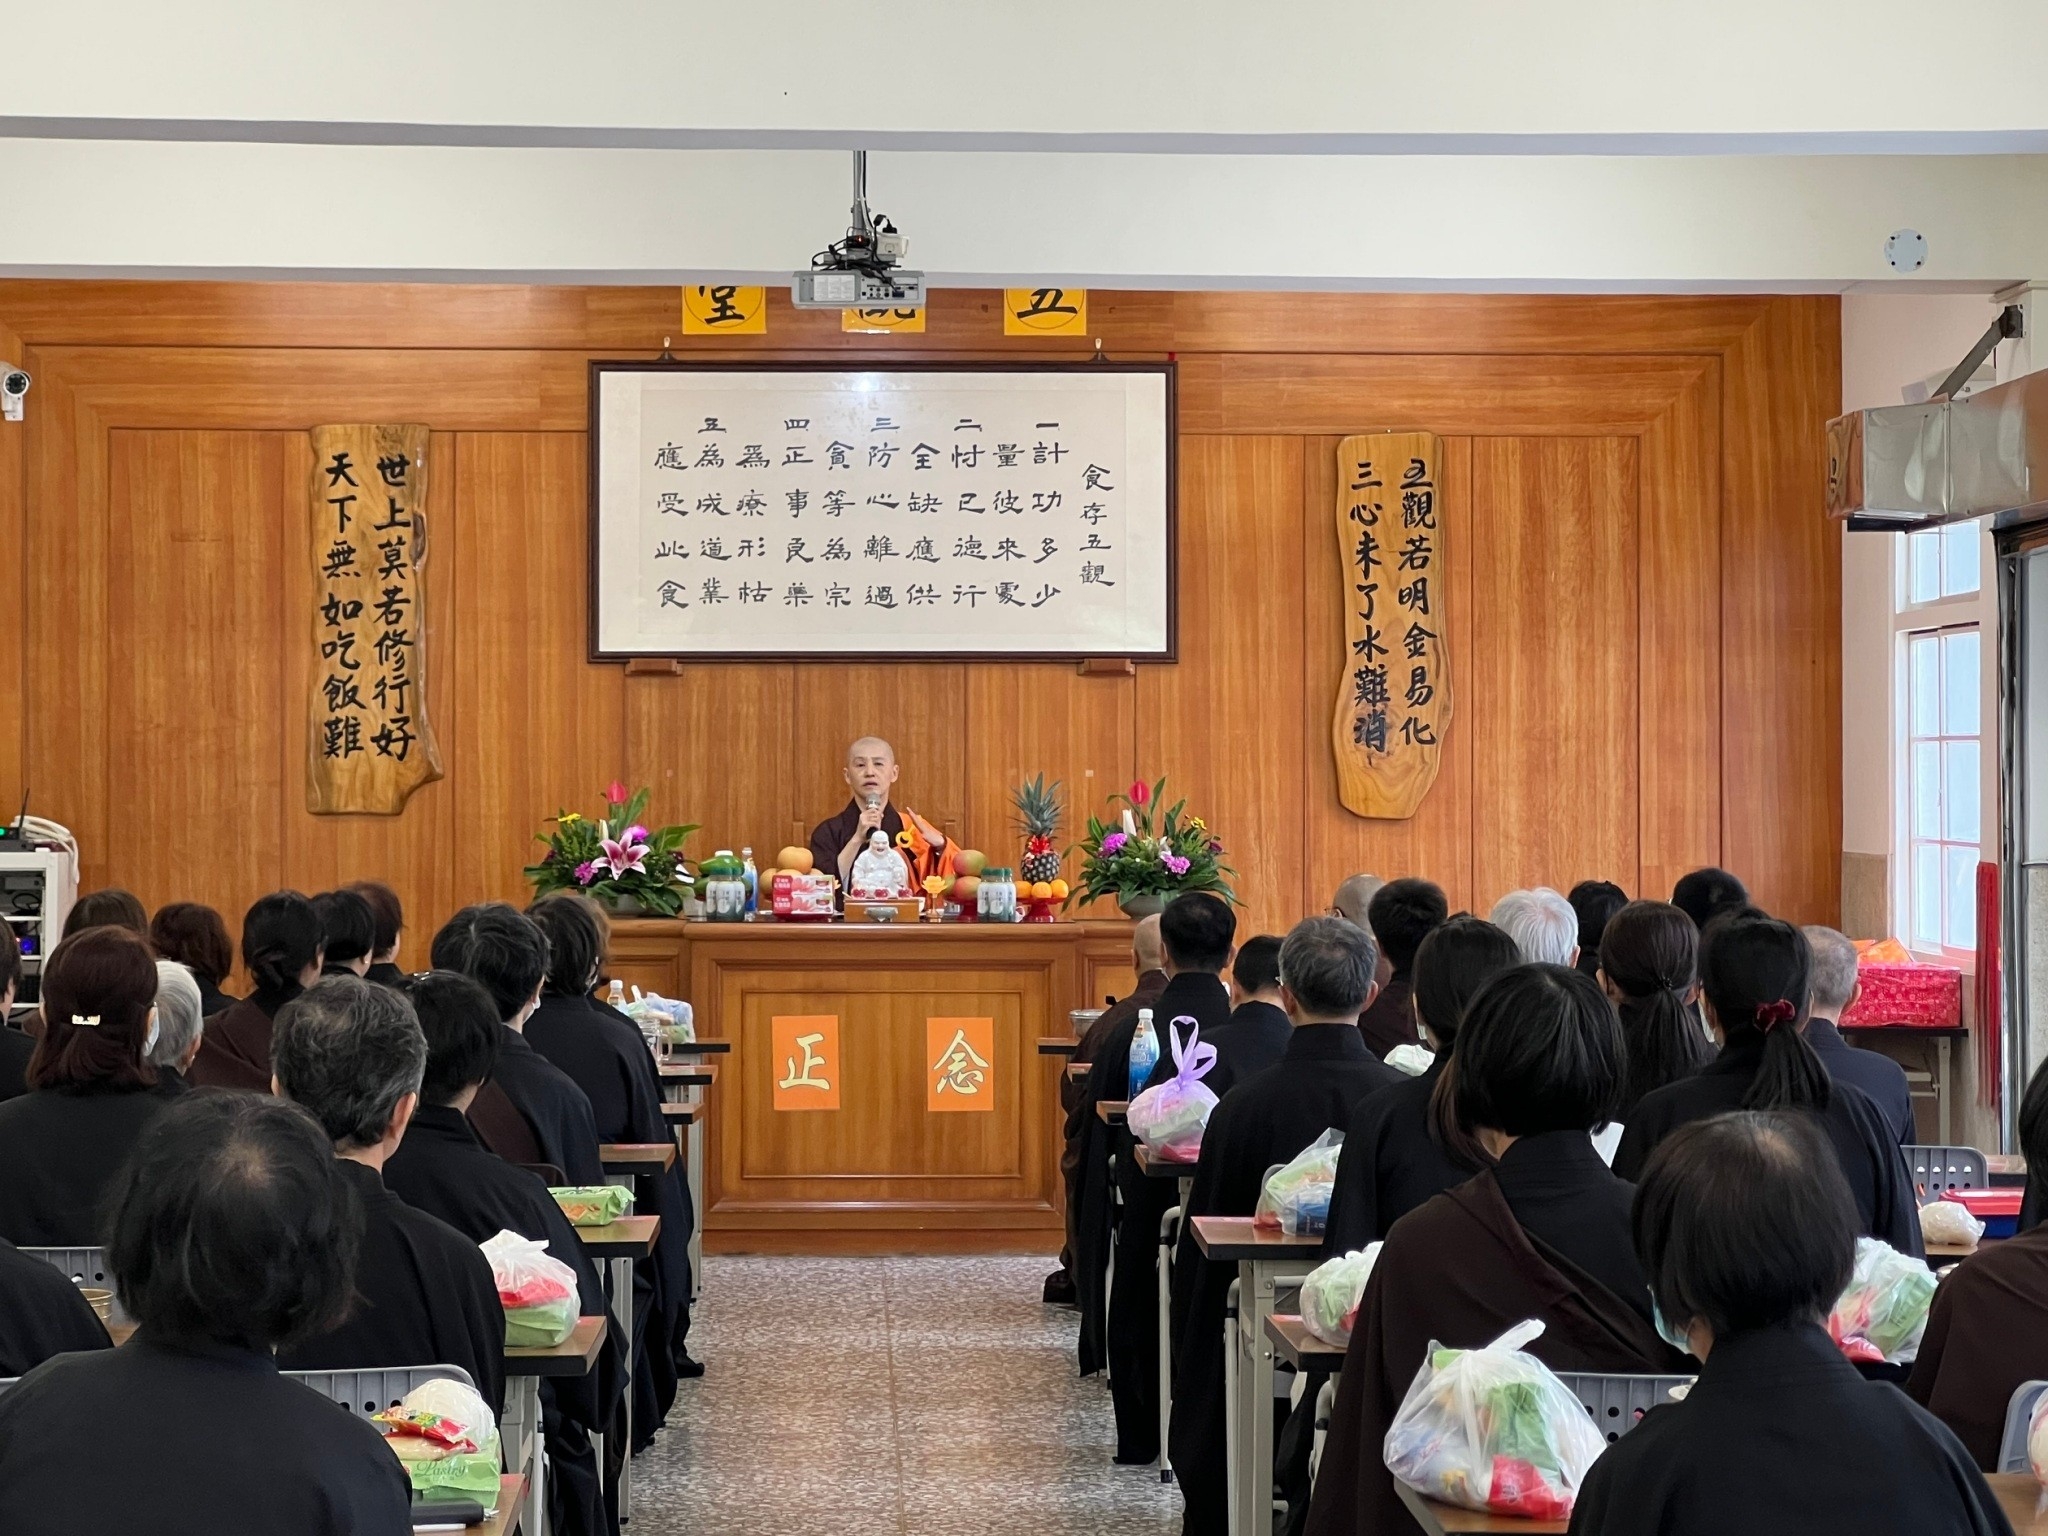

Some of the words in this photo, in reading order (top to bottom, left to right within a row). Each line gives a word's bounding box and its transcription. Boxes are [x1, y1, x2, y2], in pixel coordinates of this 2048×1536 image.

[654, 441, 690, 609] 應受此食
[693, 417, 732, 605] 五為成道業
[781, 418, 814, 608] 四正事良藥
[820, 440, 856, 608] 貪等為宗
[863, 416, 900, 609] 三防心離過
[905, 442, 943, 605] 全缺應供
[991, 443, 1026, 608] 量彼來處
[1031, 421, 1069, 608] 一計功多少
[1079, 463, 1115, 587] 食存五觀
[1397, 457, 1439, 747] 五觀若明金易化
[320, 452, 367, 760] 天下無如吃飯難
[370, 453, 417, 762] 世上莫若修行好
[1349, 461, 1393, 754] 三心未了水難消
[778, 1032, 831, 1090] 正
[933, 1029, 990, 1095] 念
